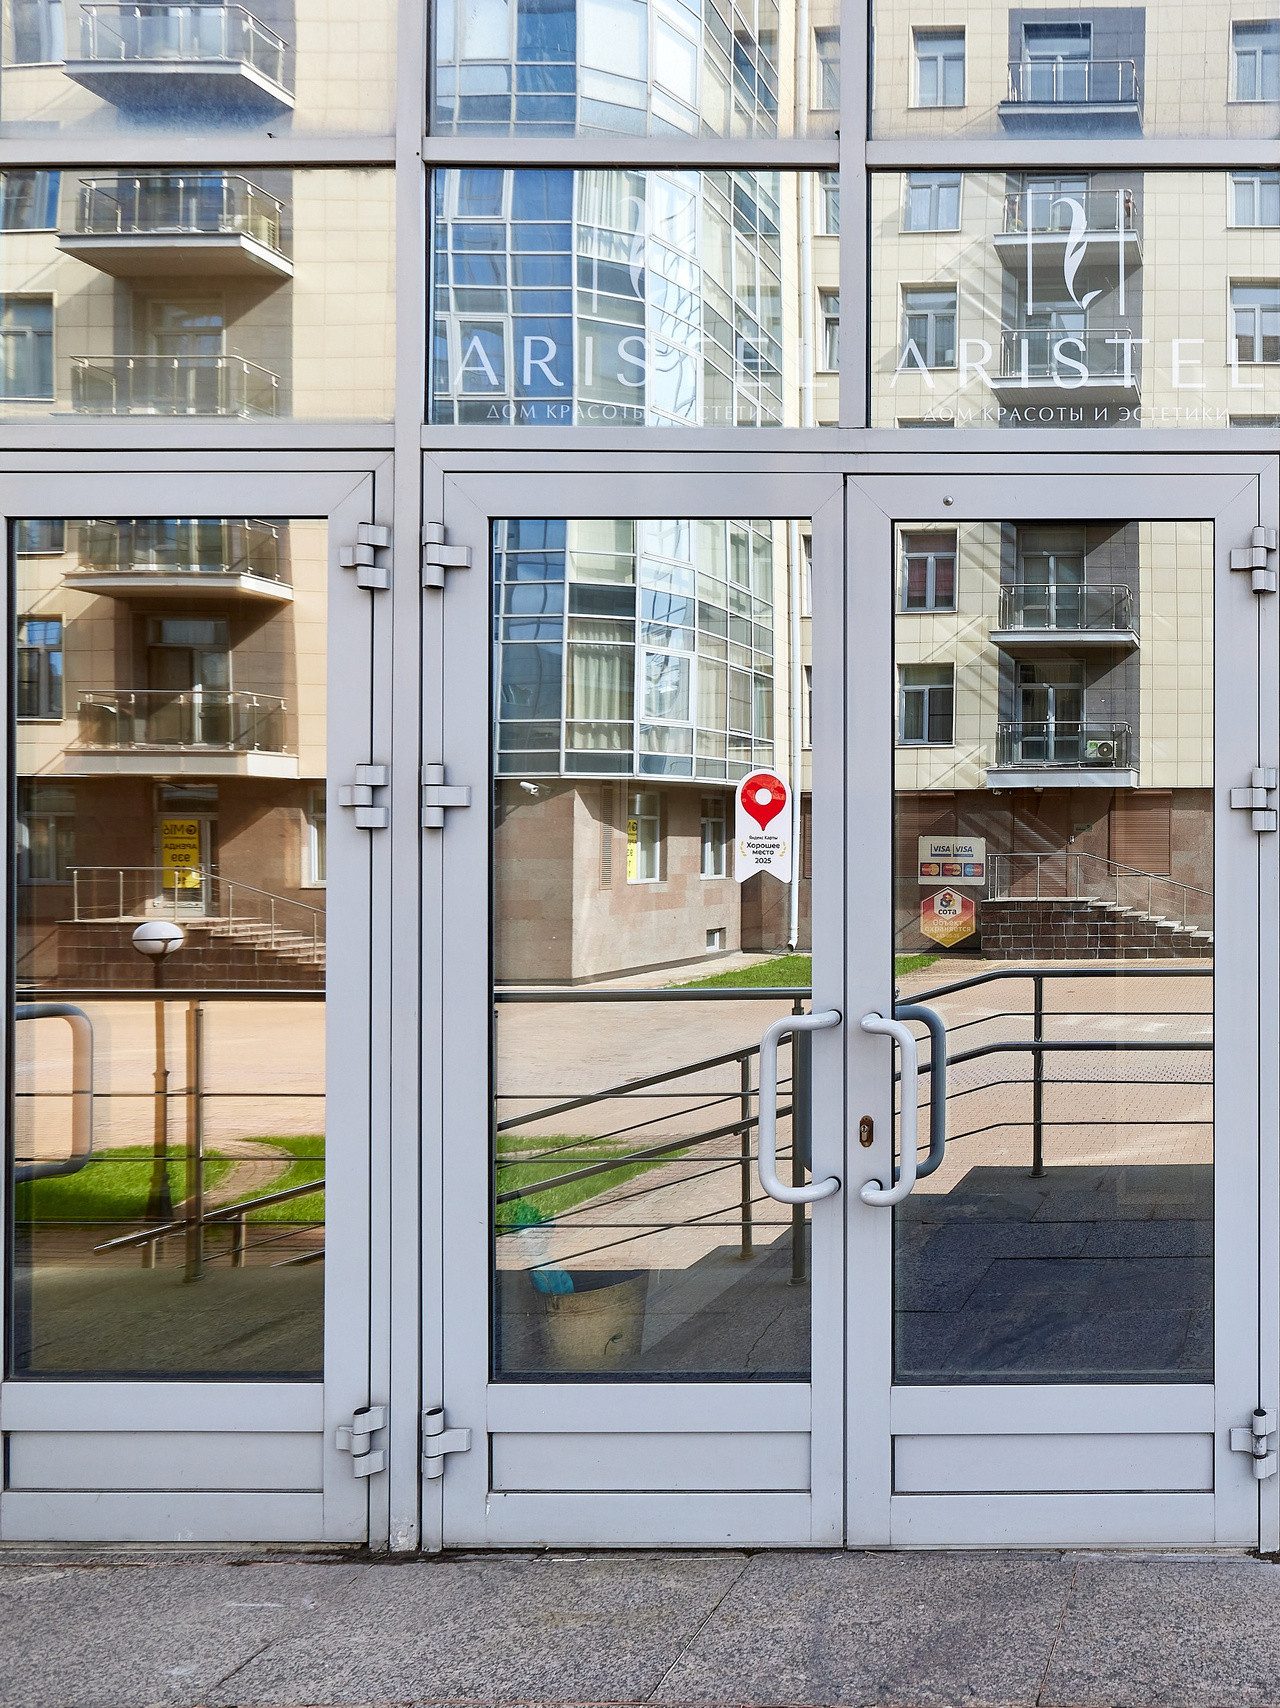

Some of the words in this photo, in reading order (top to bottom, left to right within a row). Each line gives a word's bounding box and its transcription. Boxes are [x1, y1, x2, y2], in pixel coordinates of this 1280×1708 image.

[453, 336, 828, 388] ARISEL
[889, 337, 1264, 390] ARISTEL
[486, 404, 536, 420] ДОМ
[680, 405, 790, 420] СТЕТИК
[923, 406, 973, 422] ДОМ
[983, 406, 1084, 422] КРАСОТЫ
[1094, 406, 1108, 421] И
[1119, 406, 1230, 422] ЭСТЕТИКИ
[746, 841, 780, 850] Хорошее
[933, 845, 951, 853] VISA
[955, 845, 973, 853] VISA
[932, 918, 963, 927] Объект
[925, 926, 972, 934] охраняется
